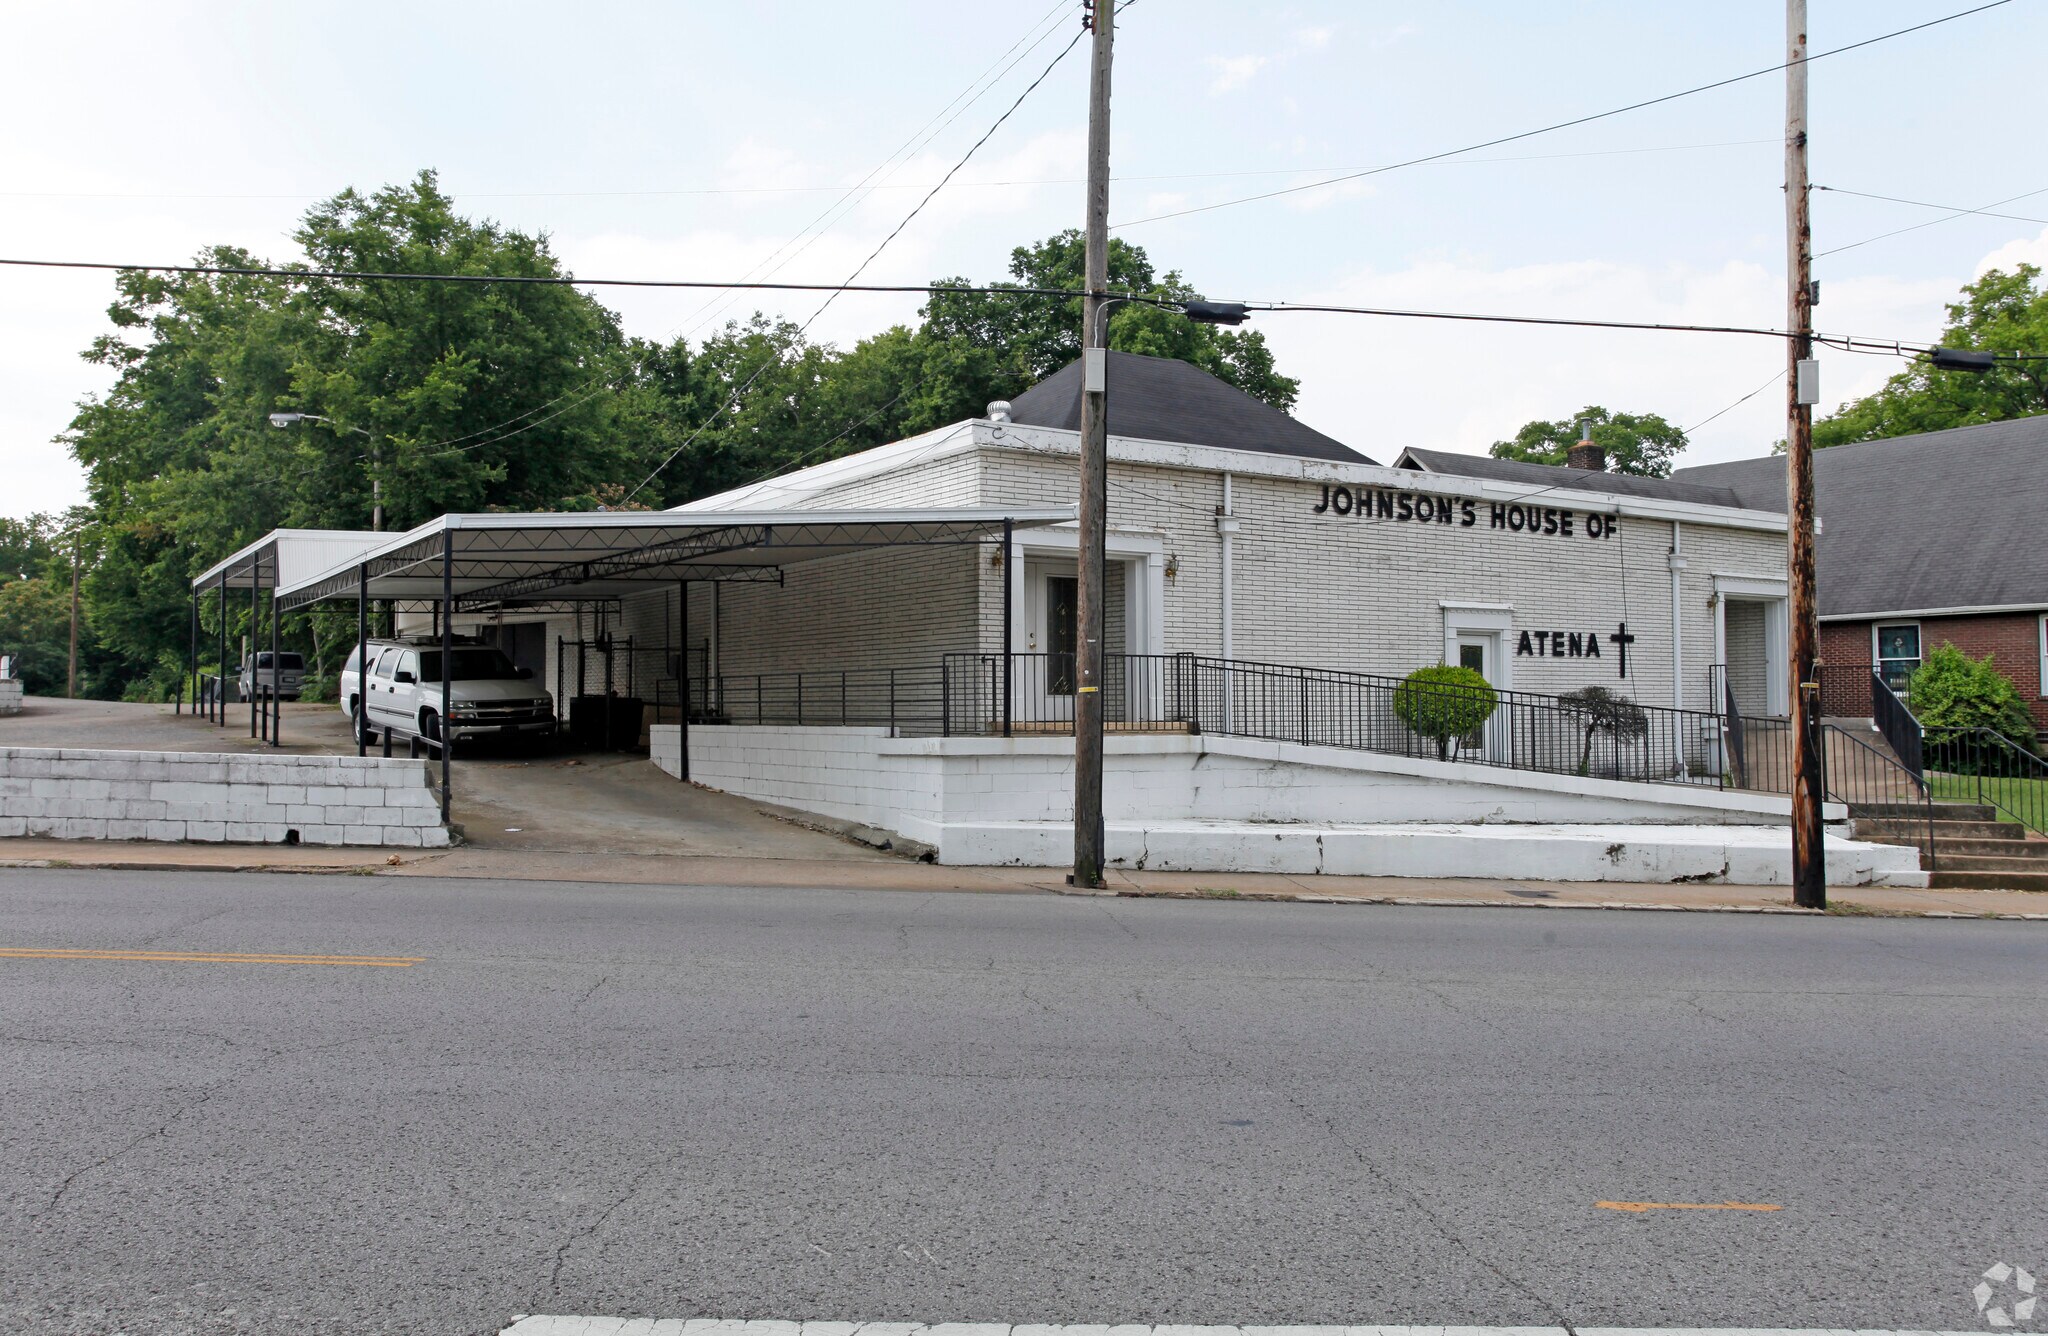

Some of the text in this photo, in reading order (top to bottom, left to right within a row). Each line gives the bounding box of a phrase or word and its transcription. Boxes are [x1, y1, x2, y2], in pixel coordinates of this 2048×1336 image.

[1314, 485, 1617, 538] JOHNSON'S HOUSE OF
[1517, 630, 1600, 657] ATENA
